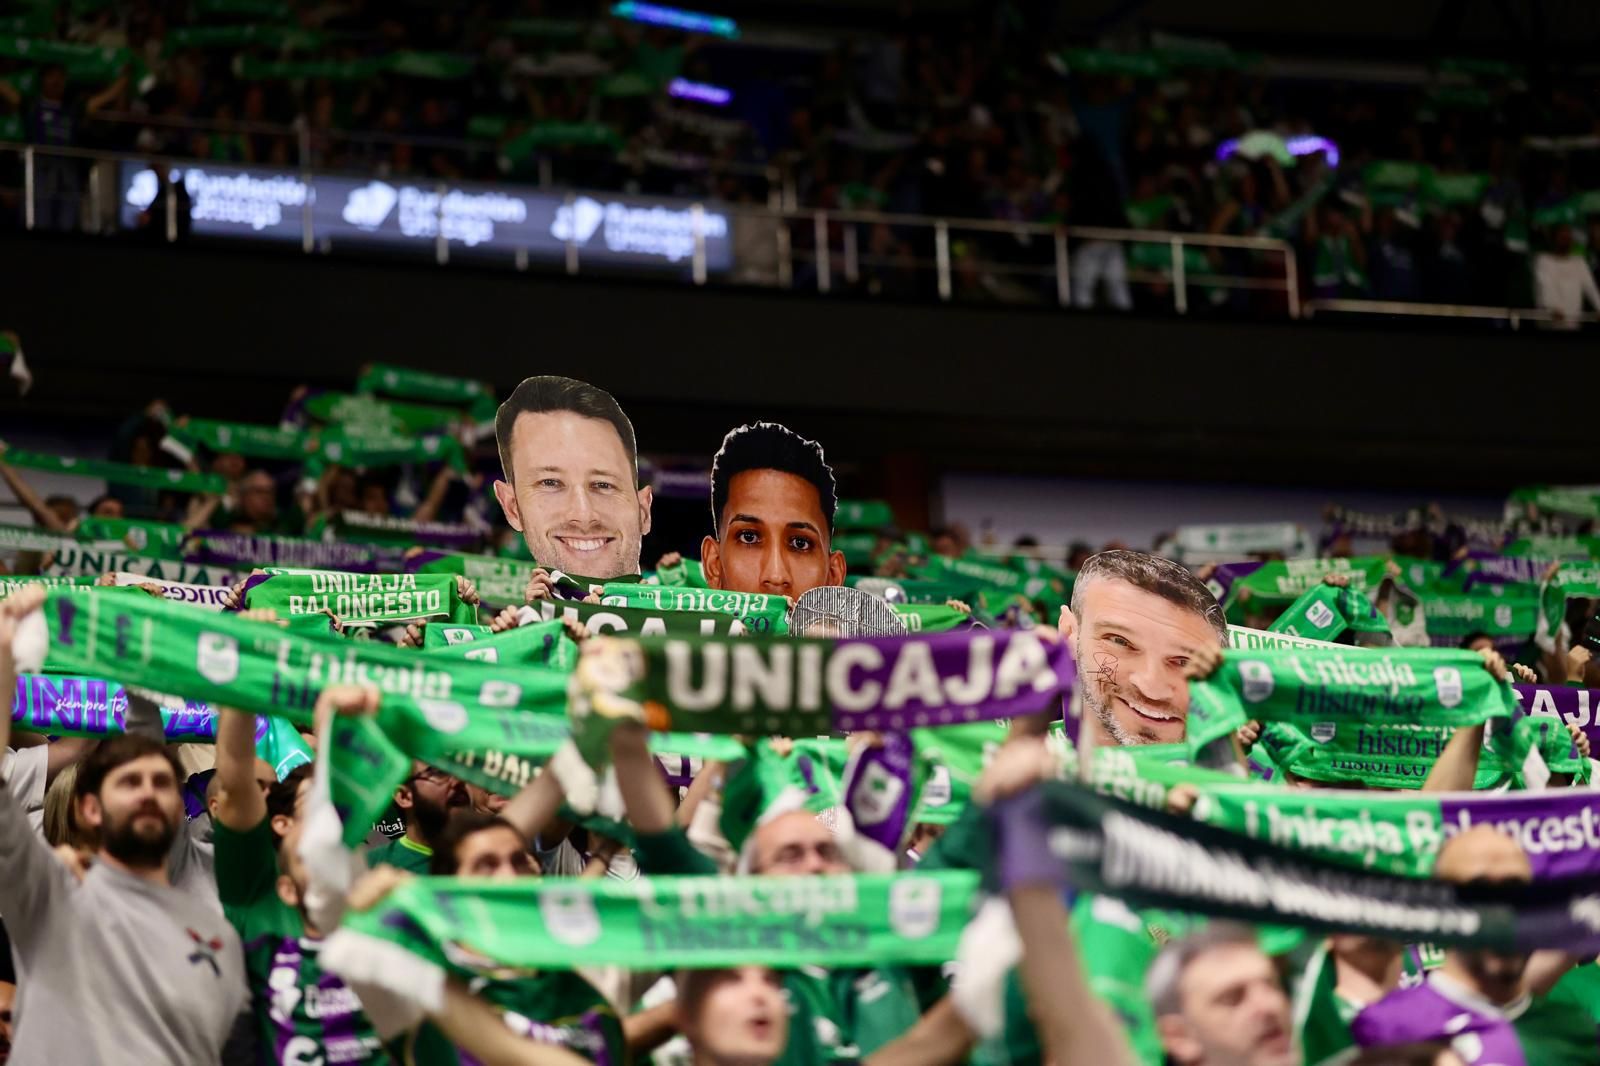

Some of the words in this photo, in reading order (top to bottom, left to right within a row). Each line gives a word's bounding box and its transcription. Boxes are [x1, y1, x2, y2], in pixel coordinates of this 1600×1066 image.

[312, 574, 416, 593] UNICAJA
[654, 589, 769, 617] Unicaja
[1293, 655, 1418, 696] Unicaja
